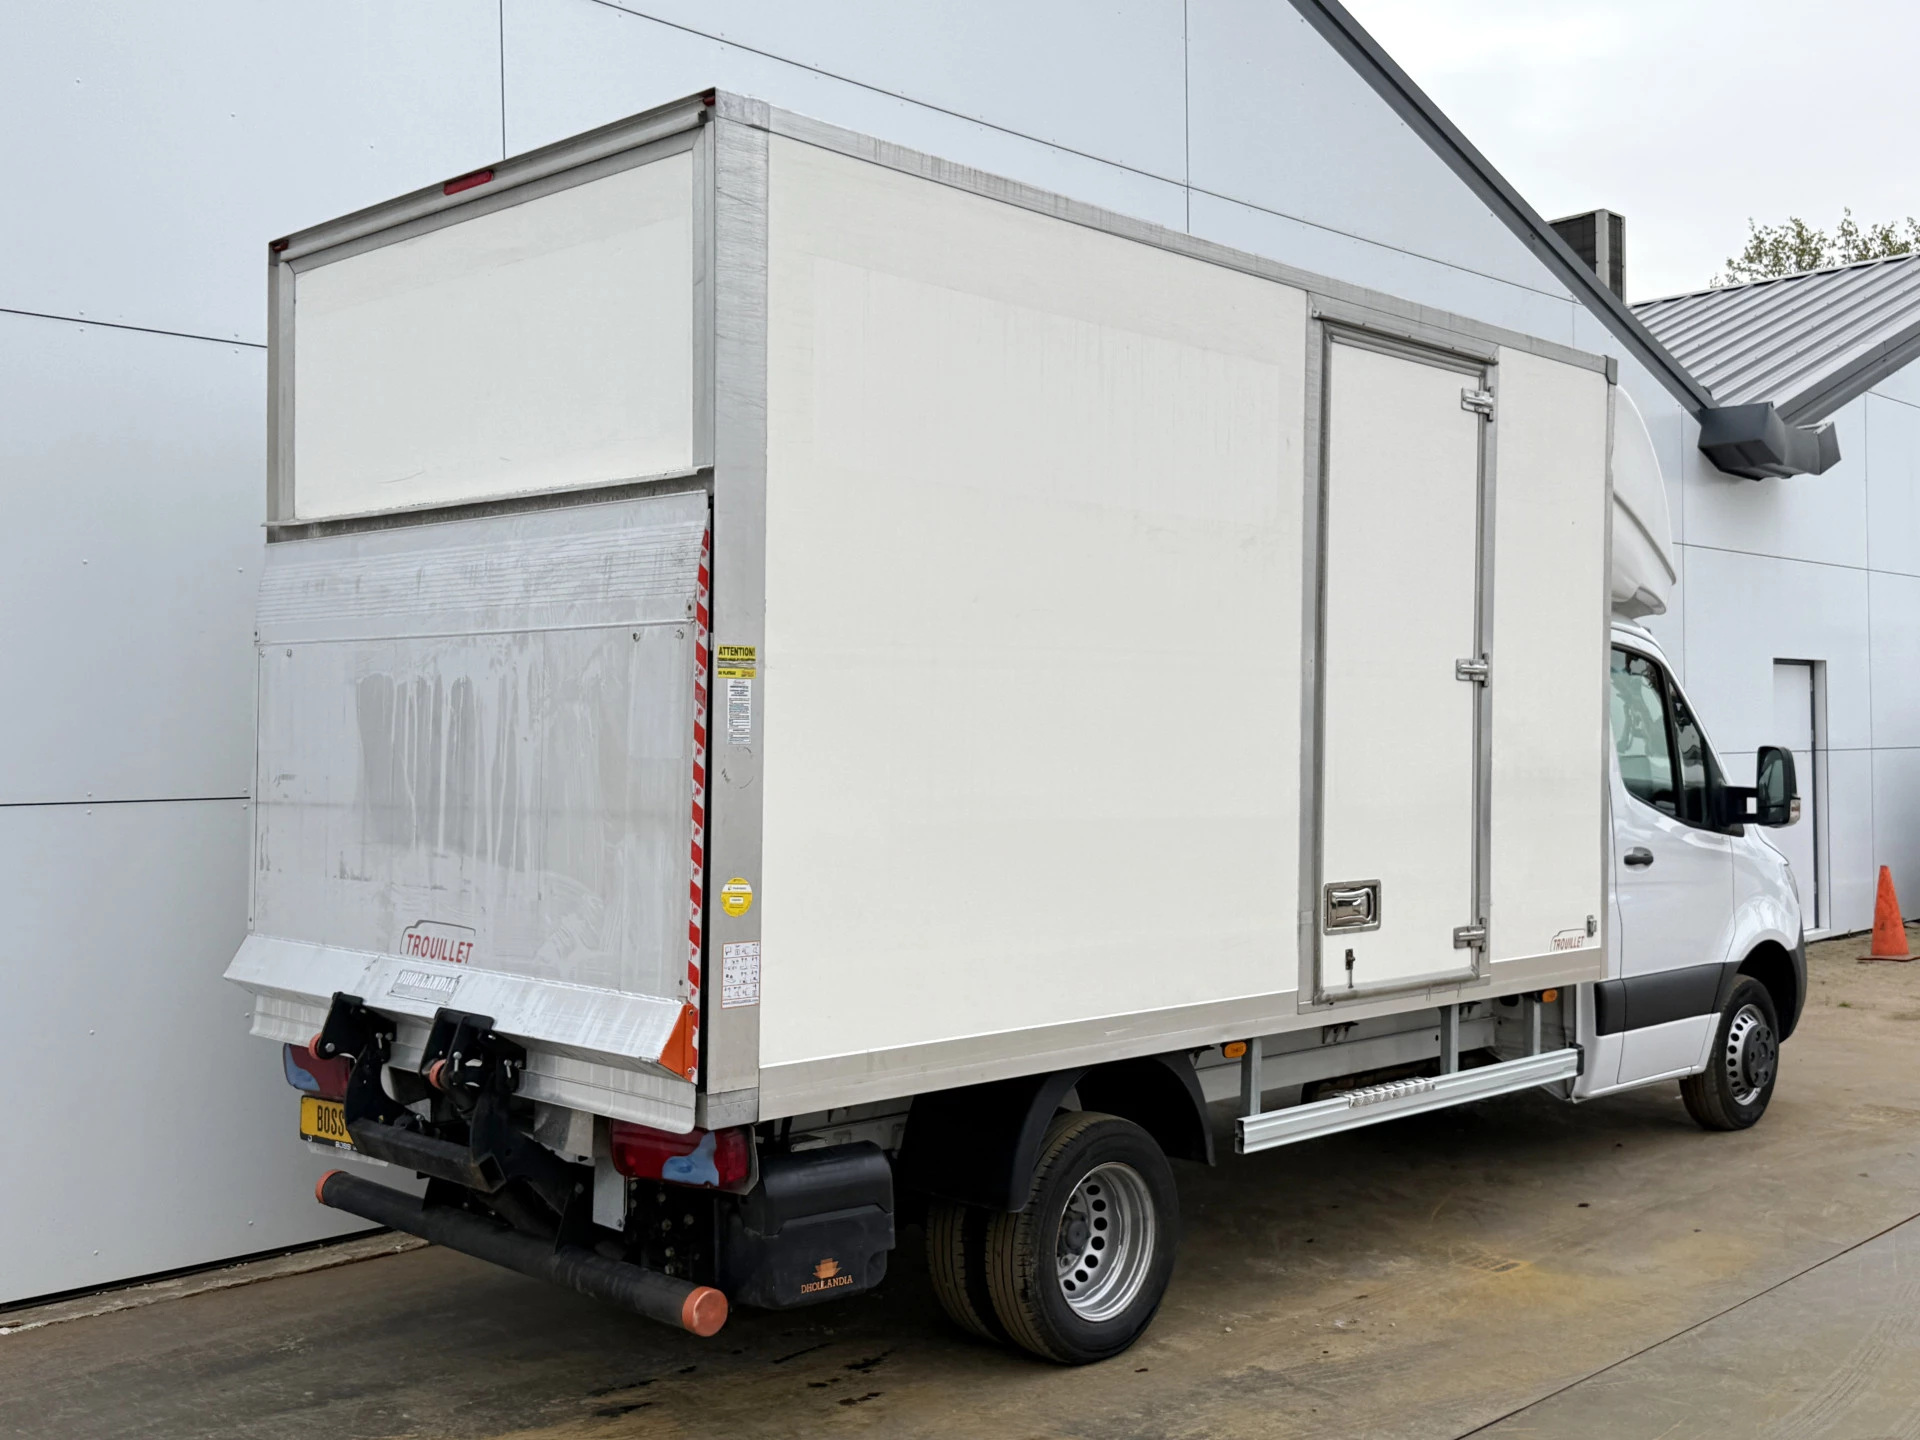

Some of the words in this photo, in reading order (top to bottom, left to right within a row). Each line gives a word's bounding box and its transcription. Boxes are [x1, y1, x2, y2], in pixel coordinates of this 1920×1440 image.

[406, 933, 474, 964] TROUILLET
[1553, 935, 1585, 951] TROUILLET
[397, 971, 457, 993] DHOLLANDIA
[801, 1274, 854, 1294] DHOLLANDIA
